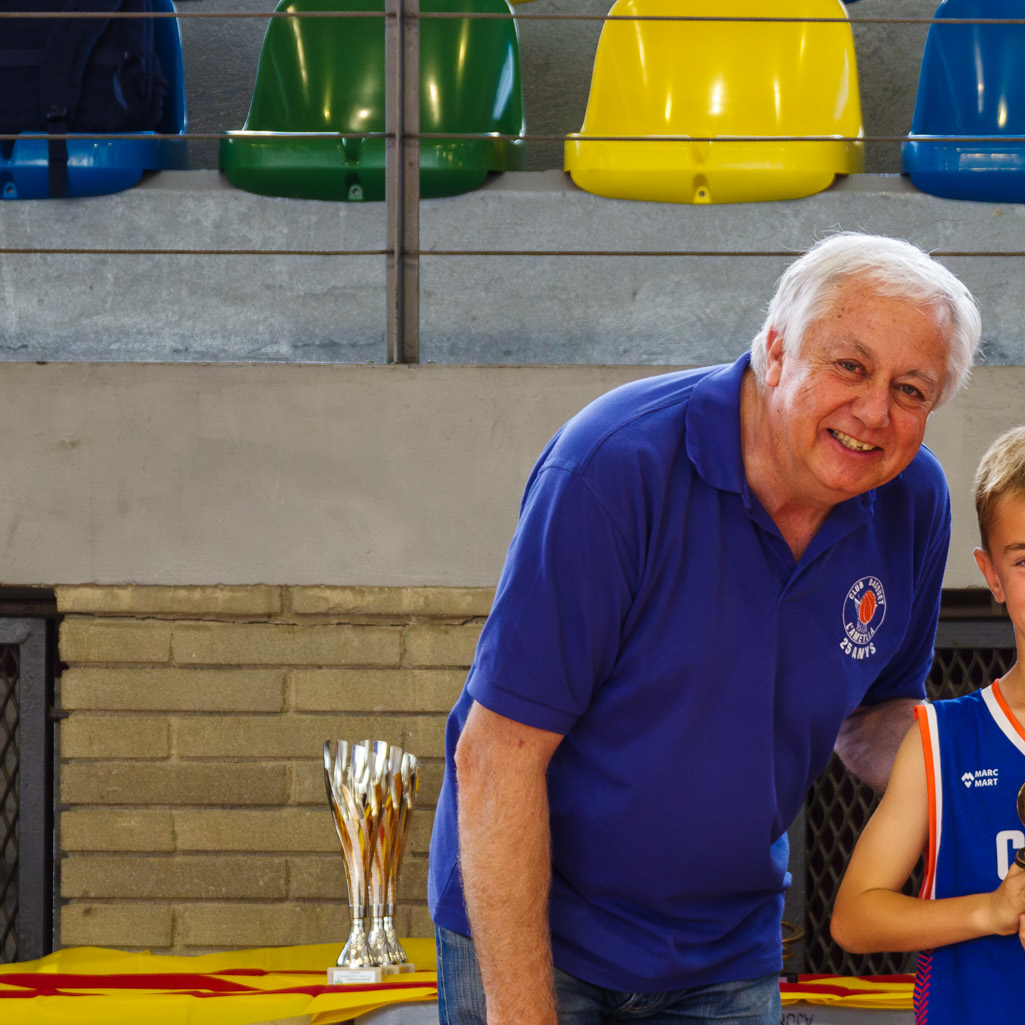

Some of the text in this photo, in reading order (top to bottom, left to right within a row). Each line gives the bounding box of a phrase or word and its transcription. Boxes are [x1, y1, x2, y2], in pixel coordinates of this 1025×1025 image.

[849, 581, 864, 600] CLUB
[840, 637, 876, 660] 25 ANYS
[974, 768, 999, 778] MARC
[974, 778, 999, 788] MART
